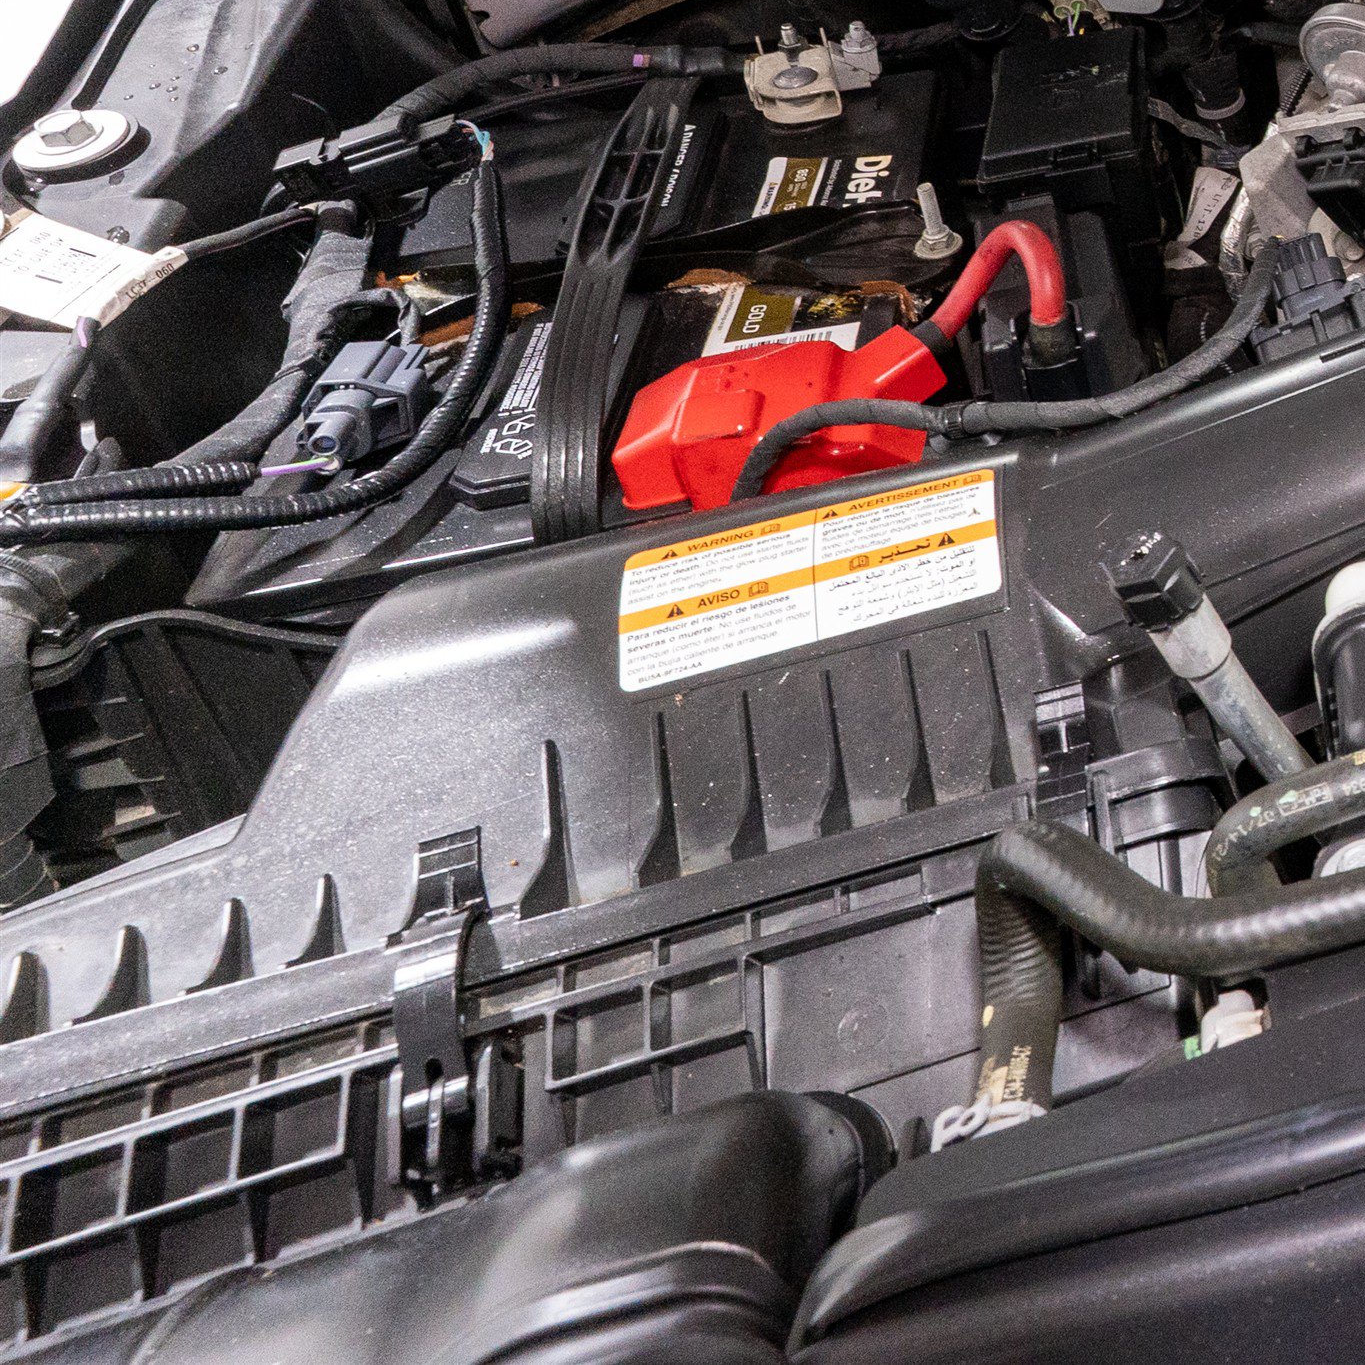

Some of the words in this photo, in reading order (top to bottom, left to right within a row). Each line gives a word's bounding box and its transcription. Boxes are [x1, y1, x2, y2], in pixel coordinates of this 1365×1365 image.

[743, 305, 767, 333] GOLD
[848, 479, 959, 512] AVERTISSEMENT
[645, 562, 678, 574] reduce
[681, 556, 698, 565] risk
[713, 543, 754, 558] possible
[757, 534, 790, 545] serious
[687, 530, 754, 552] WARNING
[781, 545, 808, 557] starter
[629, 574, 656, 586] injury
[697, 589, 740, 608] AVISO
[627, 632, 650, 643] Para
[653, 621, 687, 636] reducir
[690, 617, 699, 626] el
[702, 610, 733, 624] riesgo
[735, 606, 747, 614] de
[751, 595, 790, 611] lesiones
[628, 638, 666, 654] severas
[719, 620, 732, 628] No
[735, 616, 751, 625] use
[754, 608, 783, 620] fluidos
[786, 603, 797, 611] de
[627, 647, 670, 666] arranque
[672, 639, 701, 654] (como
[738, 621, 772, 636] arranca
[786, 611, 811, 622] motor
[627, 666, 644, 676] con
[684, 644, 720, 661] caliente
[723, 641, 734, 650] de
